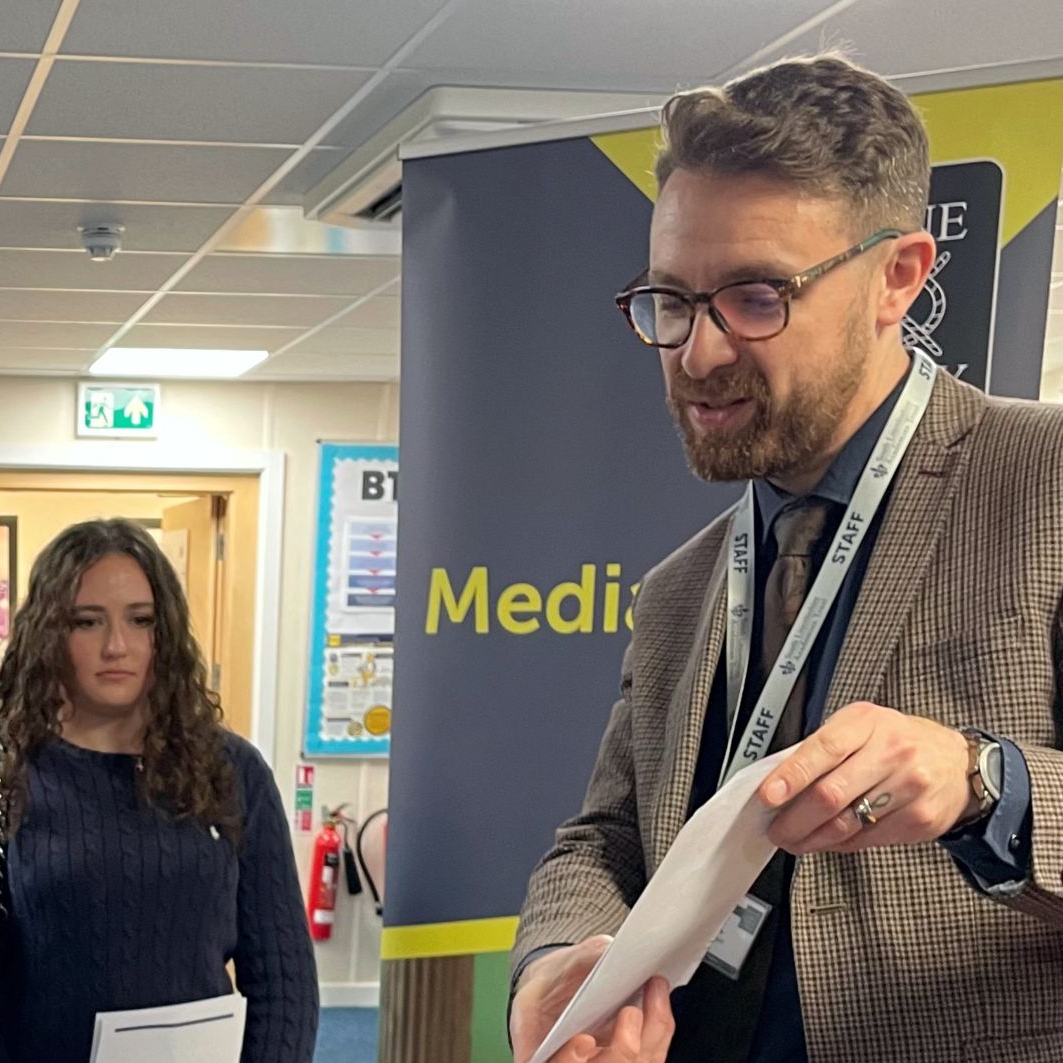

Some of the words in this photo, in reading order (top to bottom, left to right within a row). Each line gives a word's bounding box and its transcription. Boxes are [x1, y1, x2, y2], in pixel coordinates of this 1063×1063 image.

[733, 533, 748, 573] STAFF
[832, 512, 864, 565] STAFF
[425, 563, 642, 635] Medi
[744, 708, 774, 761] STAFF
